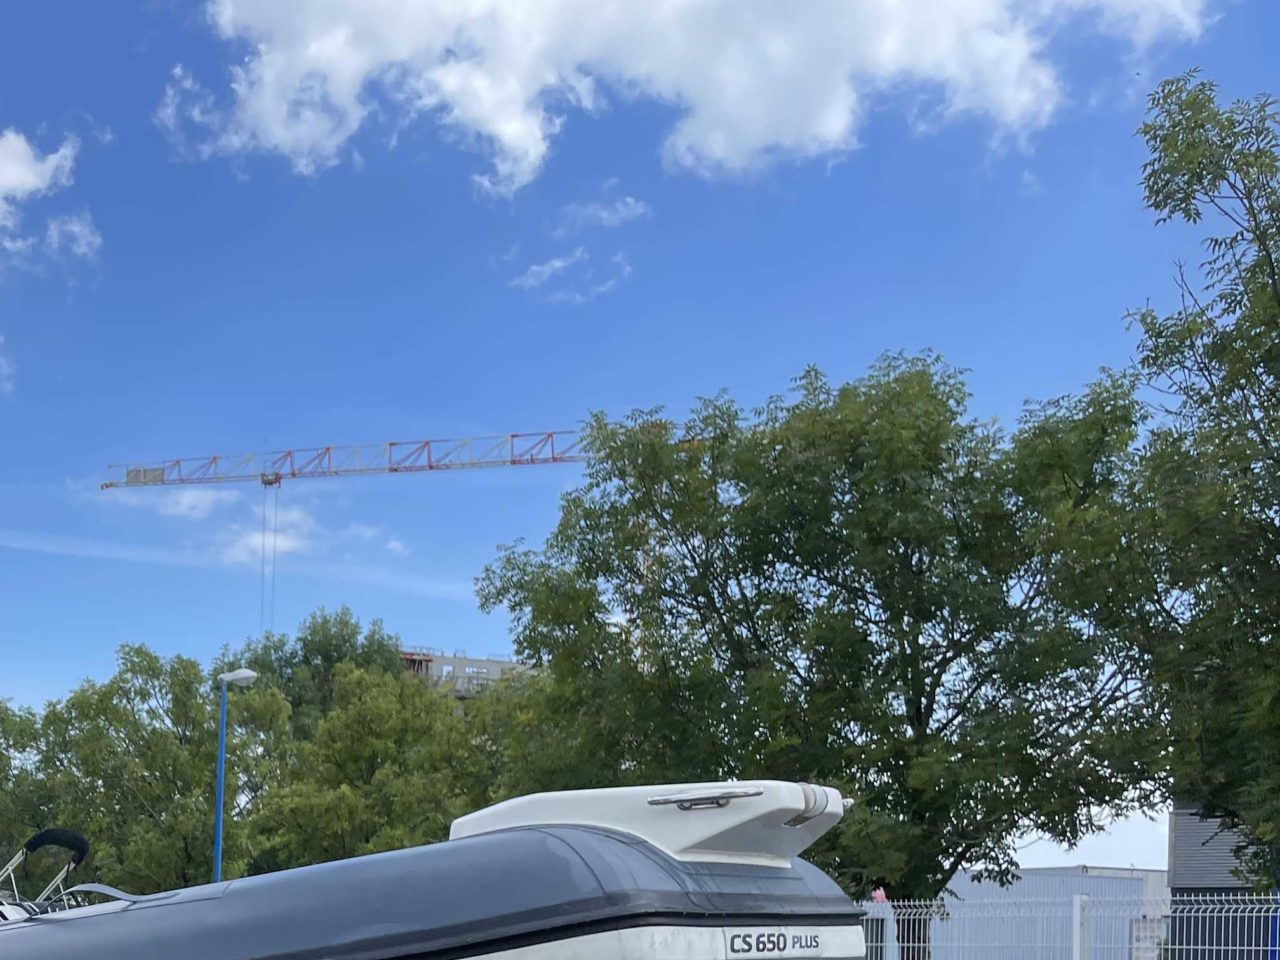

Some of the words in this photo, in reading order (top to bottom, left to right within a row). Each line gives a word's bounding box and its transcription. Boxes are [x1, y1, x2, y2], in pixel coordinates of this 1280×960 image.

[729, 933, 753, 953] CS
[755, 932, 787, 953] 650
[791, 935, 820, 949] PLUS
